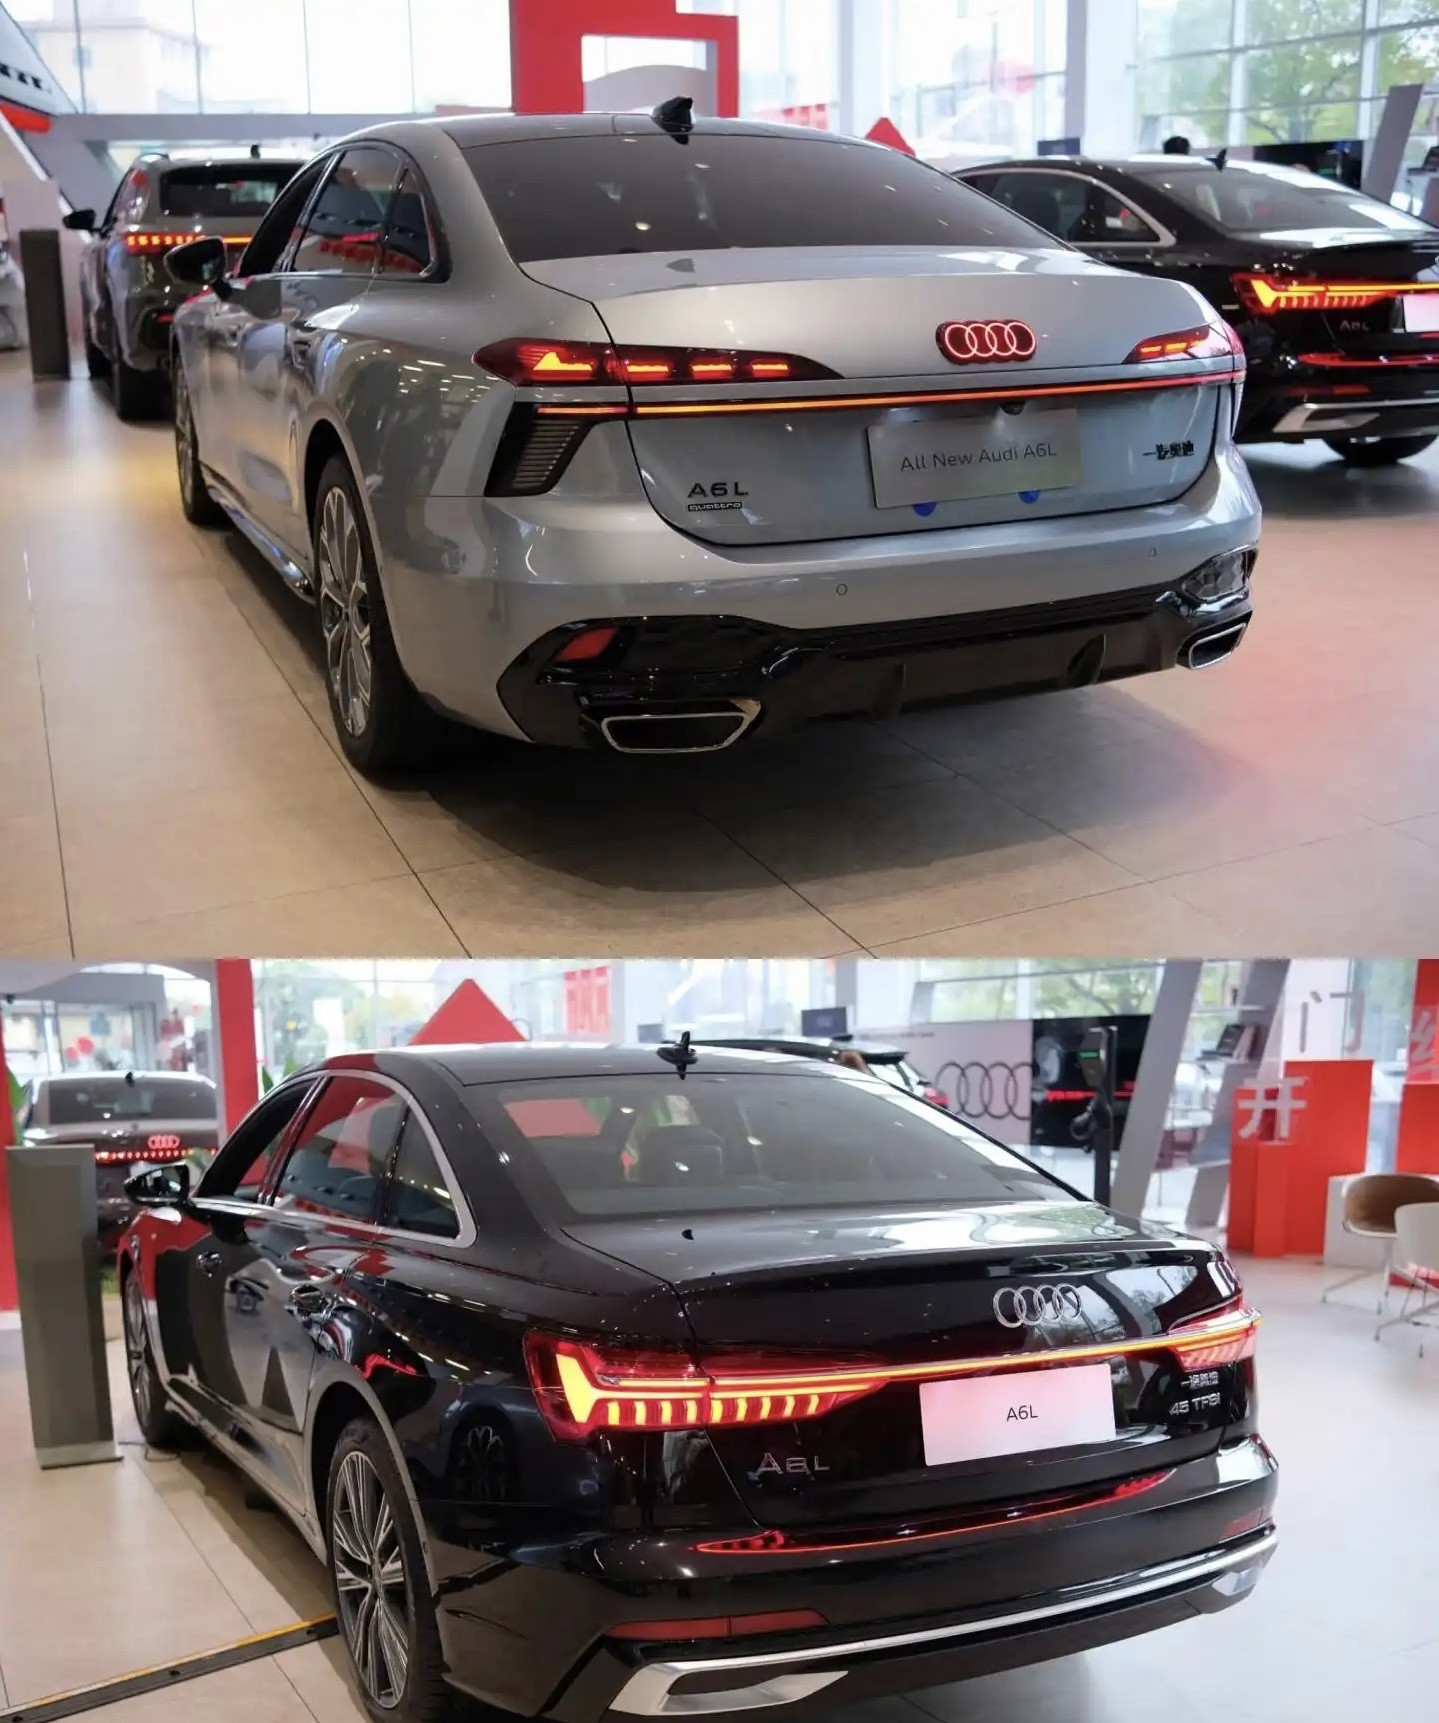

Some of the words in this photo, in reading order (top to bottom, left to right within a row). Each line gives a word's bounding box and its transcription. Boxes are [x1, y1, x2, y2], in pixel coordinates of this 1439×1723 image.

[900, 456, 927, 472] All
[932, 450, 974, 469] New
[978, 446, 1018, 463] Audi
[1023, 443, 1057, 460] A6L
[687, 481, 749, 498] A6L
[688, 501, 742, 512] quattro
[1006, 1404, 1039, 1422] A6L
[1169, 1400, 1190, 1416] 45
[1191, 1392, 1221, 1411] TFSI
